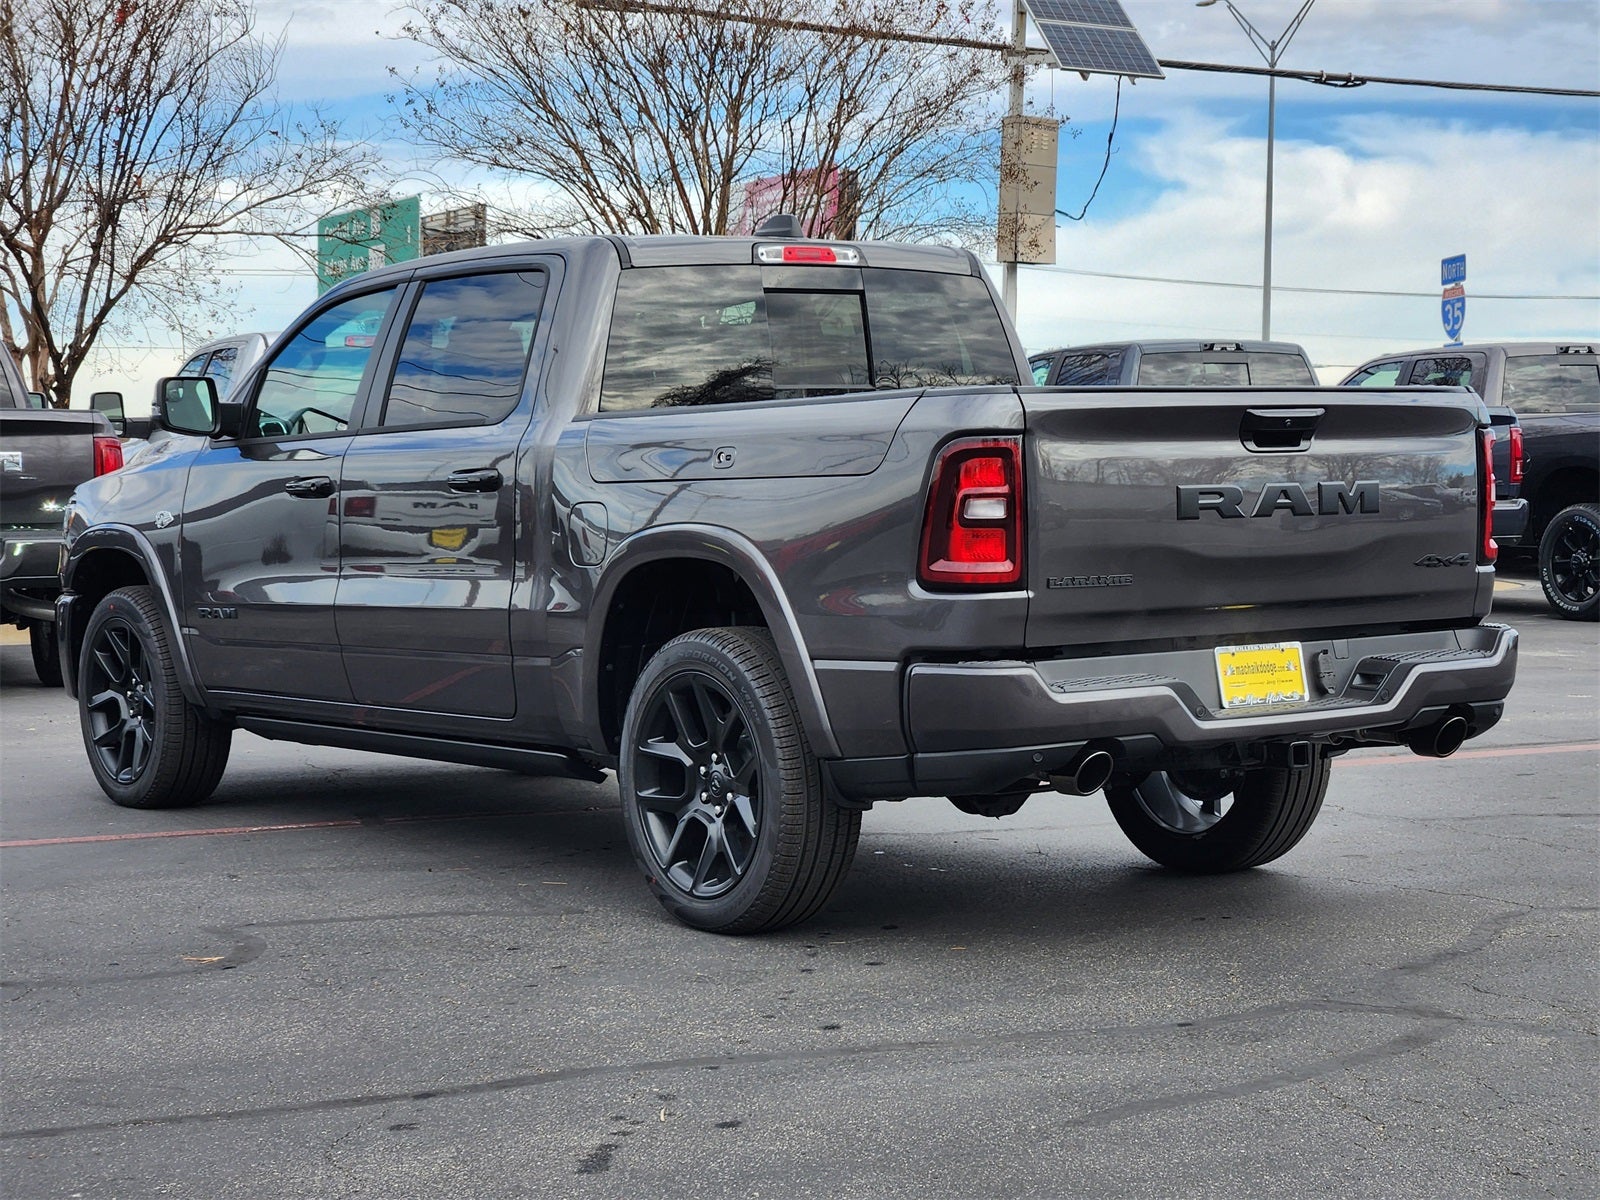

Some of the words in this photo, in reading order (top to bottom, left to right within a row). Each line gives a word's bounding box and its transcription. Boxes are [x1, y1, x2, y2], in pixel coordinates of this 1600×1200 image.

[1443, 262, 1464, 280] NORTH
[1444, 302, 1462, 331] 35
[1176, 480, 1379, 520] RAM
[1046, 574, 1134, 589] LARAMIE
[197, 607, 239, 619] RAM
